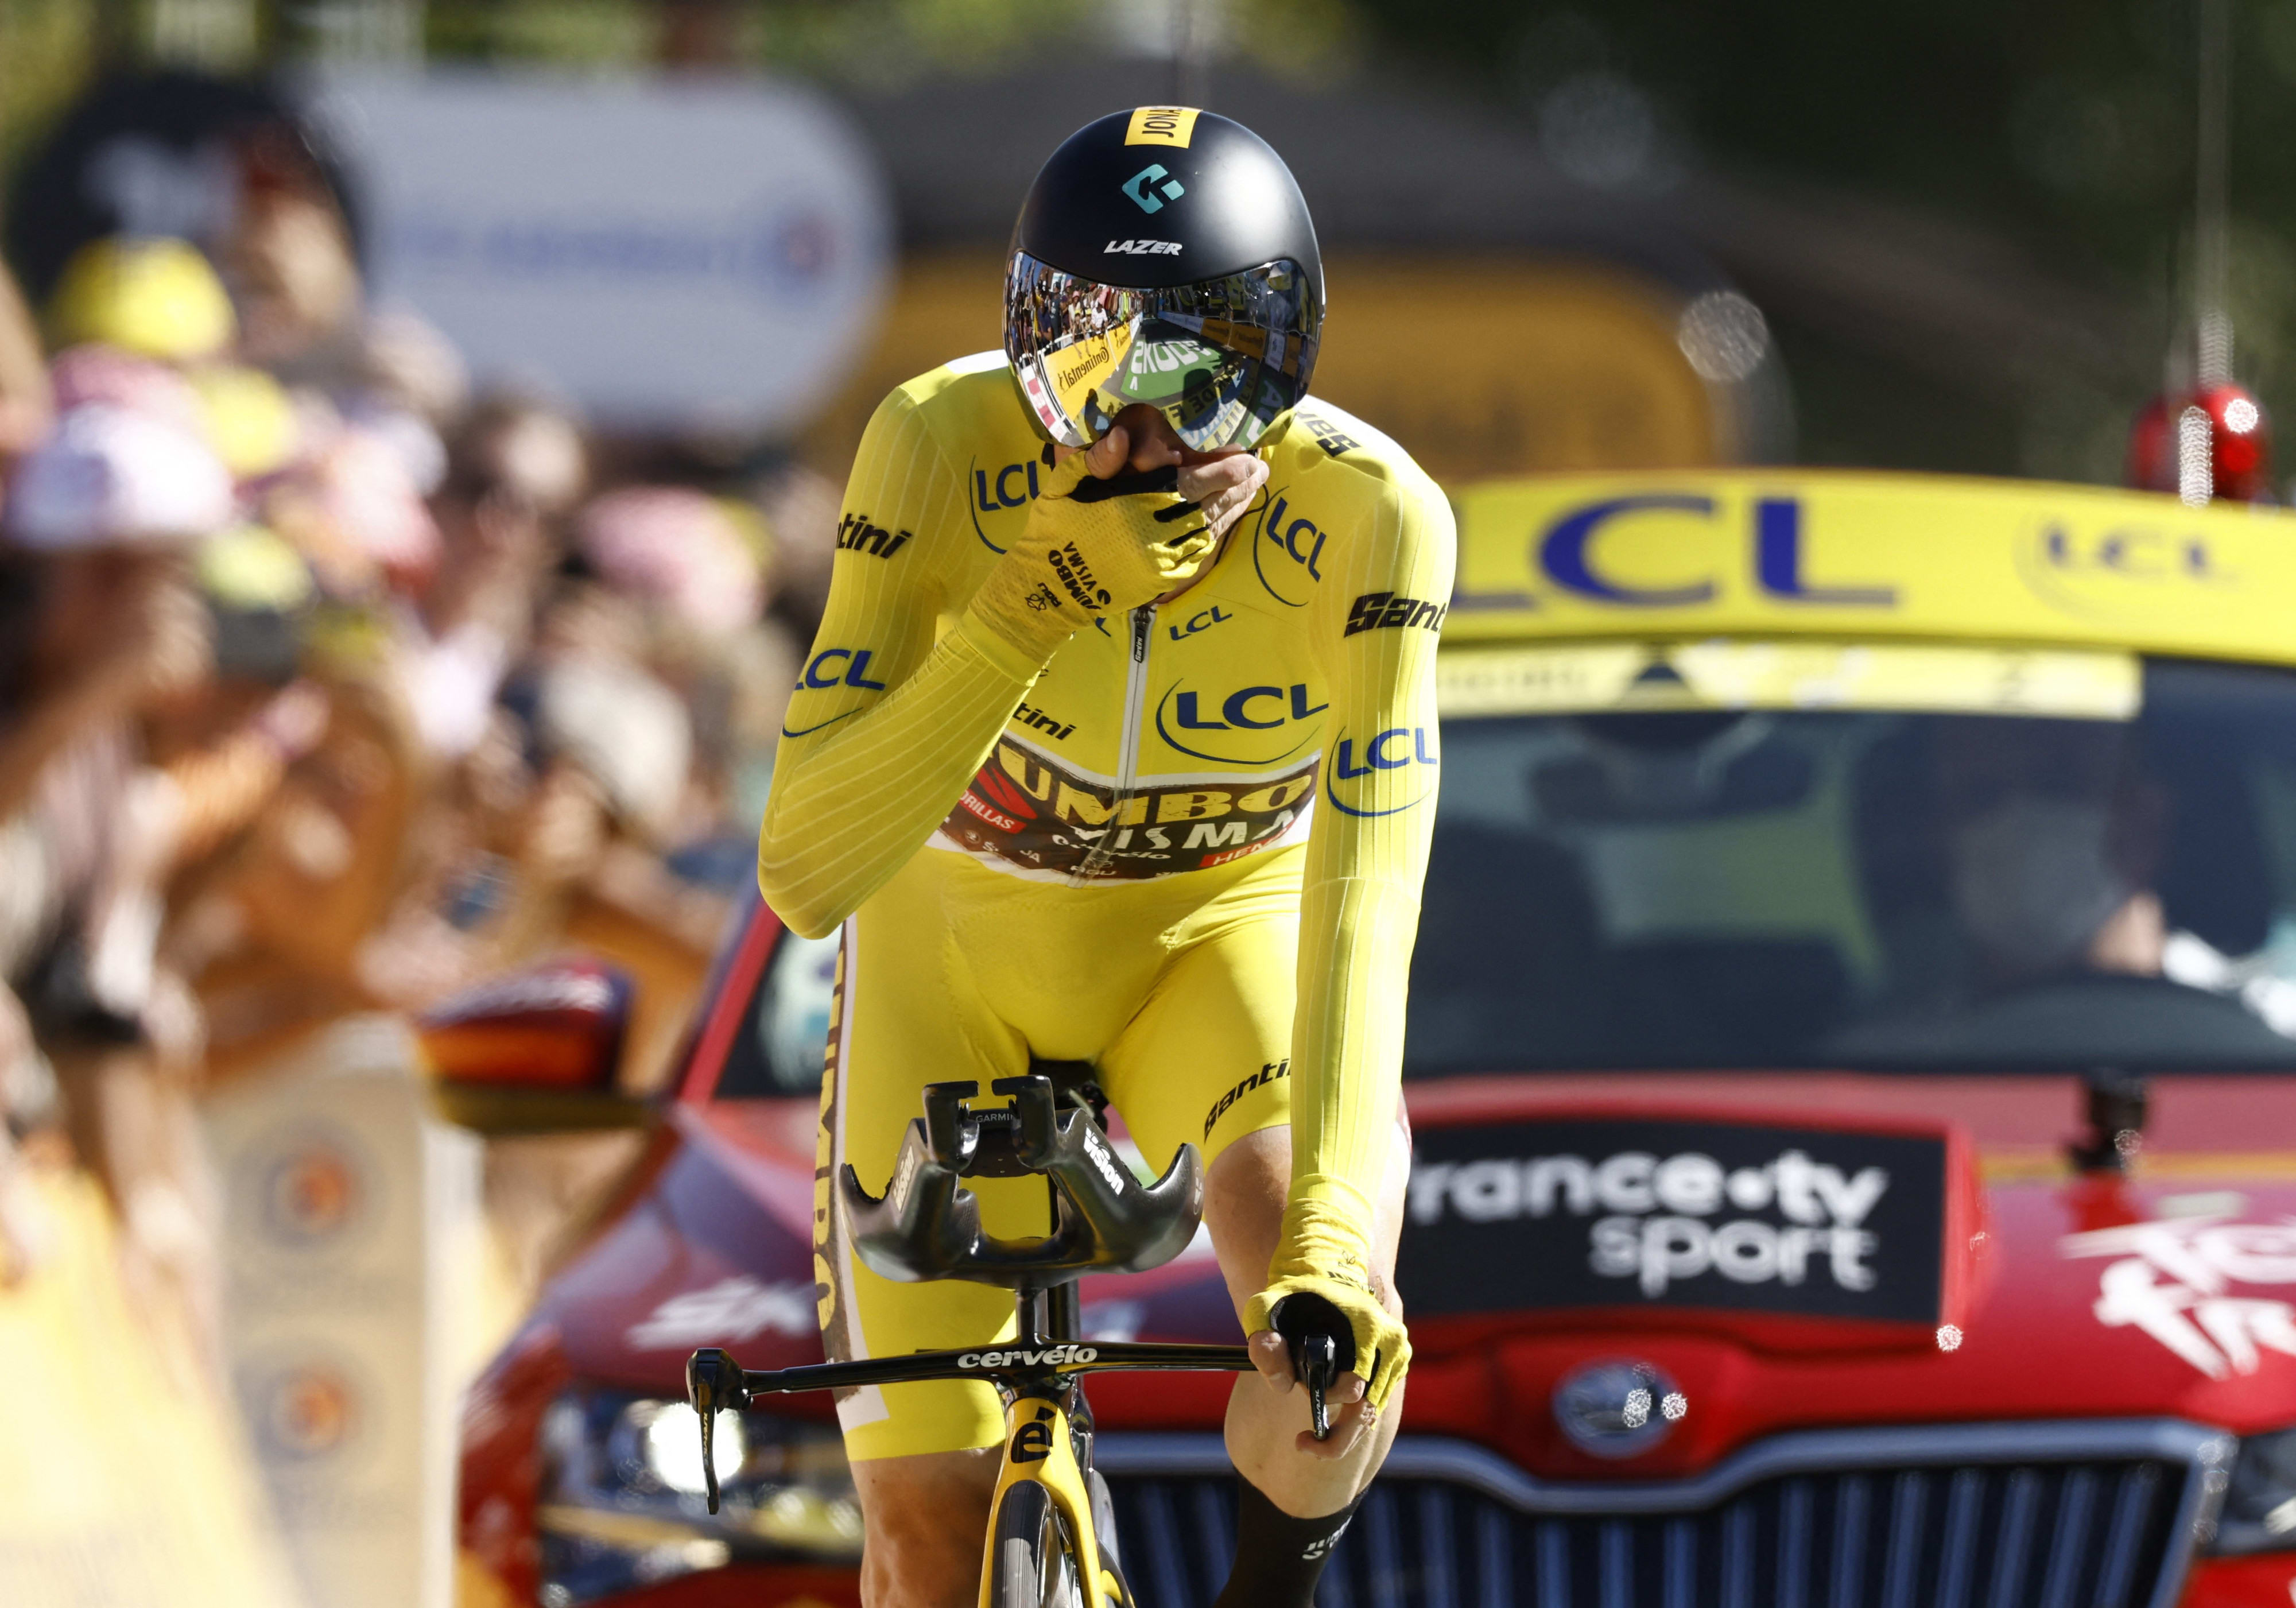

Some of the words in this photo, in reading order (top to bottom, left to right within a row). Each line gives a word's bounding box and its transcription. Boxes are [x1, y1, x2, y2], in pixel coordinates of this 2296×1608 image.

[1142, 107, 1184, 138] JONA
[1103, 240, 1183, 256] LAZER
[836, 513, 912, 559] tini
[1266, 497, 1328, 582] LCL
[1048, 549, 1102, 610] JUMBO
[1063, 541, 1097, 592] VISMA
[1169, 606, 1233, 641] LCL
[1344, 592, 1448, 638] Sant
[1177, 684, 1329, 730] LCL
[1337, 727, 1437, 780] LCL
[998, 742, 1312, 826] UMBO
[1204, 1058, 1290, 1145] Santi
[1589, 1216, 1878, 1297] sport
